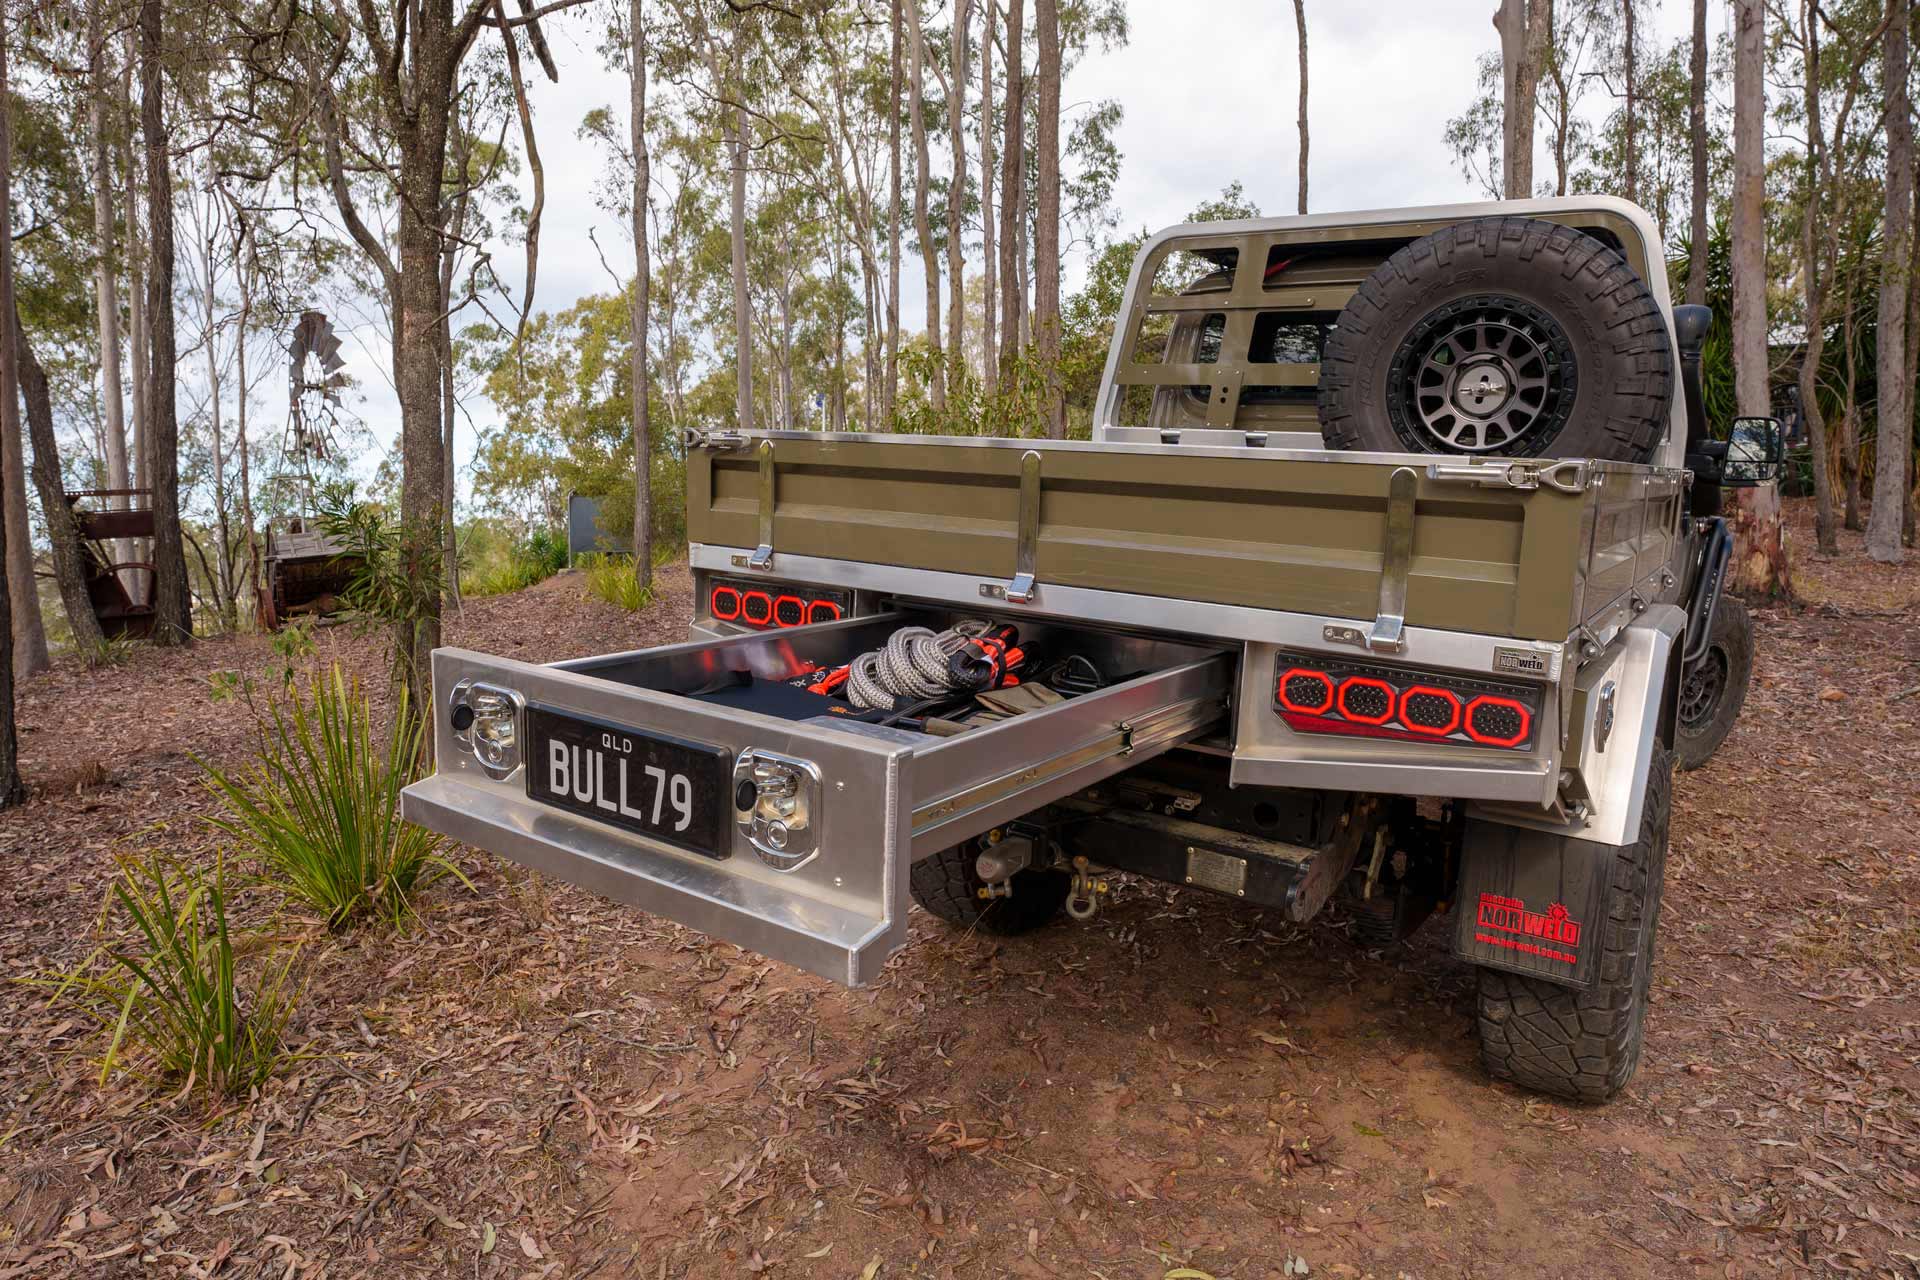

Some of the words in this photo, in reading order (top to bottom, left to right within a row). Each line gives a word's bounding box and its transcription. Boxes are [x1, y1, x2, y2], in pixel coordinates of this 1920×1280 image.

[1500, 655, 1544, 670] NORWELD
[602, 733, 632, 753] QLD
[1480, 904, 1578, 944] NORWELD
